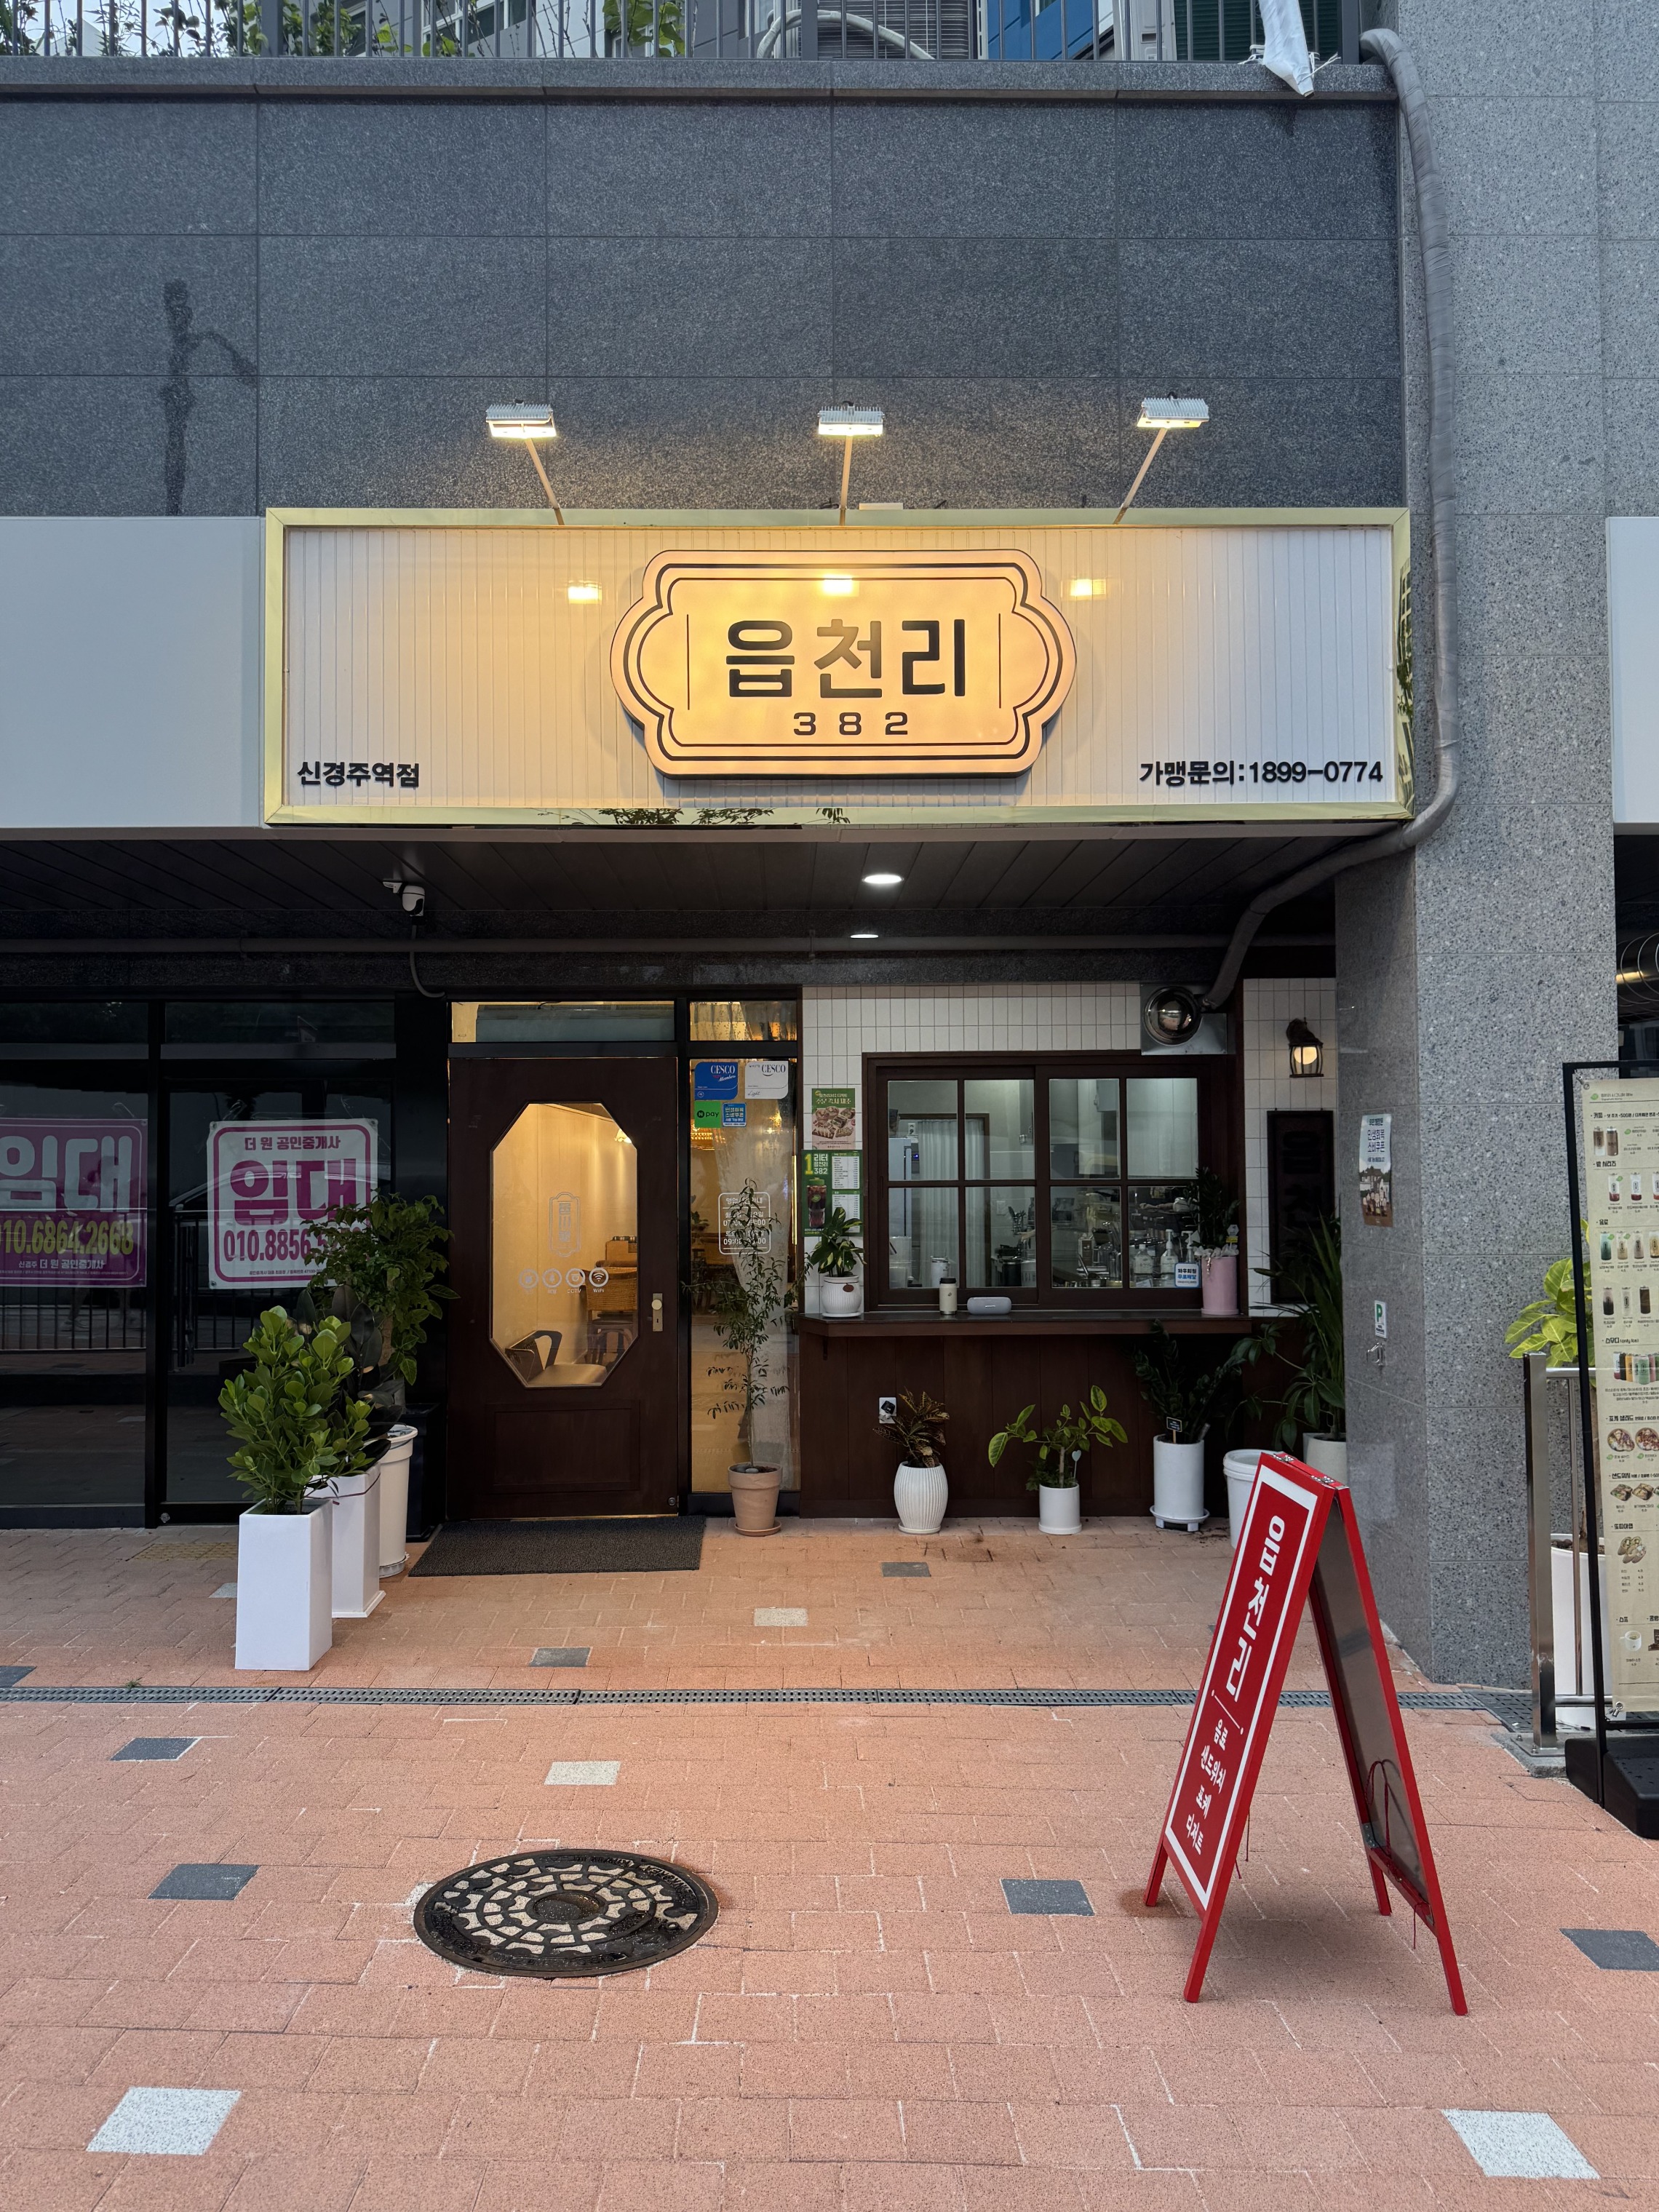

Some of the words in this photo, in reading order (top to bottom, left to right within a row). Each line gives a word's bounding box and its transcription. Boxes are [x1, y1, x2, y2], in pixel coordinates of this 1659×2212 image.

[726, 618, 966, 699] 읍천리
[793, 712, 908, 736] 382
[297, 761, 420, 787] 신경주역점
[1139, 760, 1383, 787] 가맹문의:1899-0774
[710, 1065, 736, 1074] CESCO
[761, 1064, 786, 1073] CESCO
[244, 1137, 256, 1150] 더
[260, 1137, 273, 1150] 원
[276, 1135, 341, 1150] 공인중개사
[805, 1153, 813, 1174] 1
[813, 1153, 828, 1161] 리터
[0, 1135, 132, 1212] 임대
[230, 1158, 357, 1226] 임대
[0, 1220, 134, 1255] 10.6864.2668
[18, 1260, 37, 1269] 신경주
[39, 1260, 47, 1269] 더
[50, 1260, 59, 1268] 원
[61, 1259, 106, 1269] 공인중개사
[1376, 1303, 1382, 1322] P
[1225, 1515, 1286, 1703] 읍천리
[1214, 1719, 1228, 1751] 음료
[1195, 1784, 1212, 1820] 포케
[1186, 1813, 1204, 1855] 디저트
